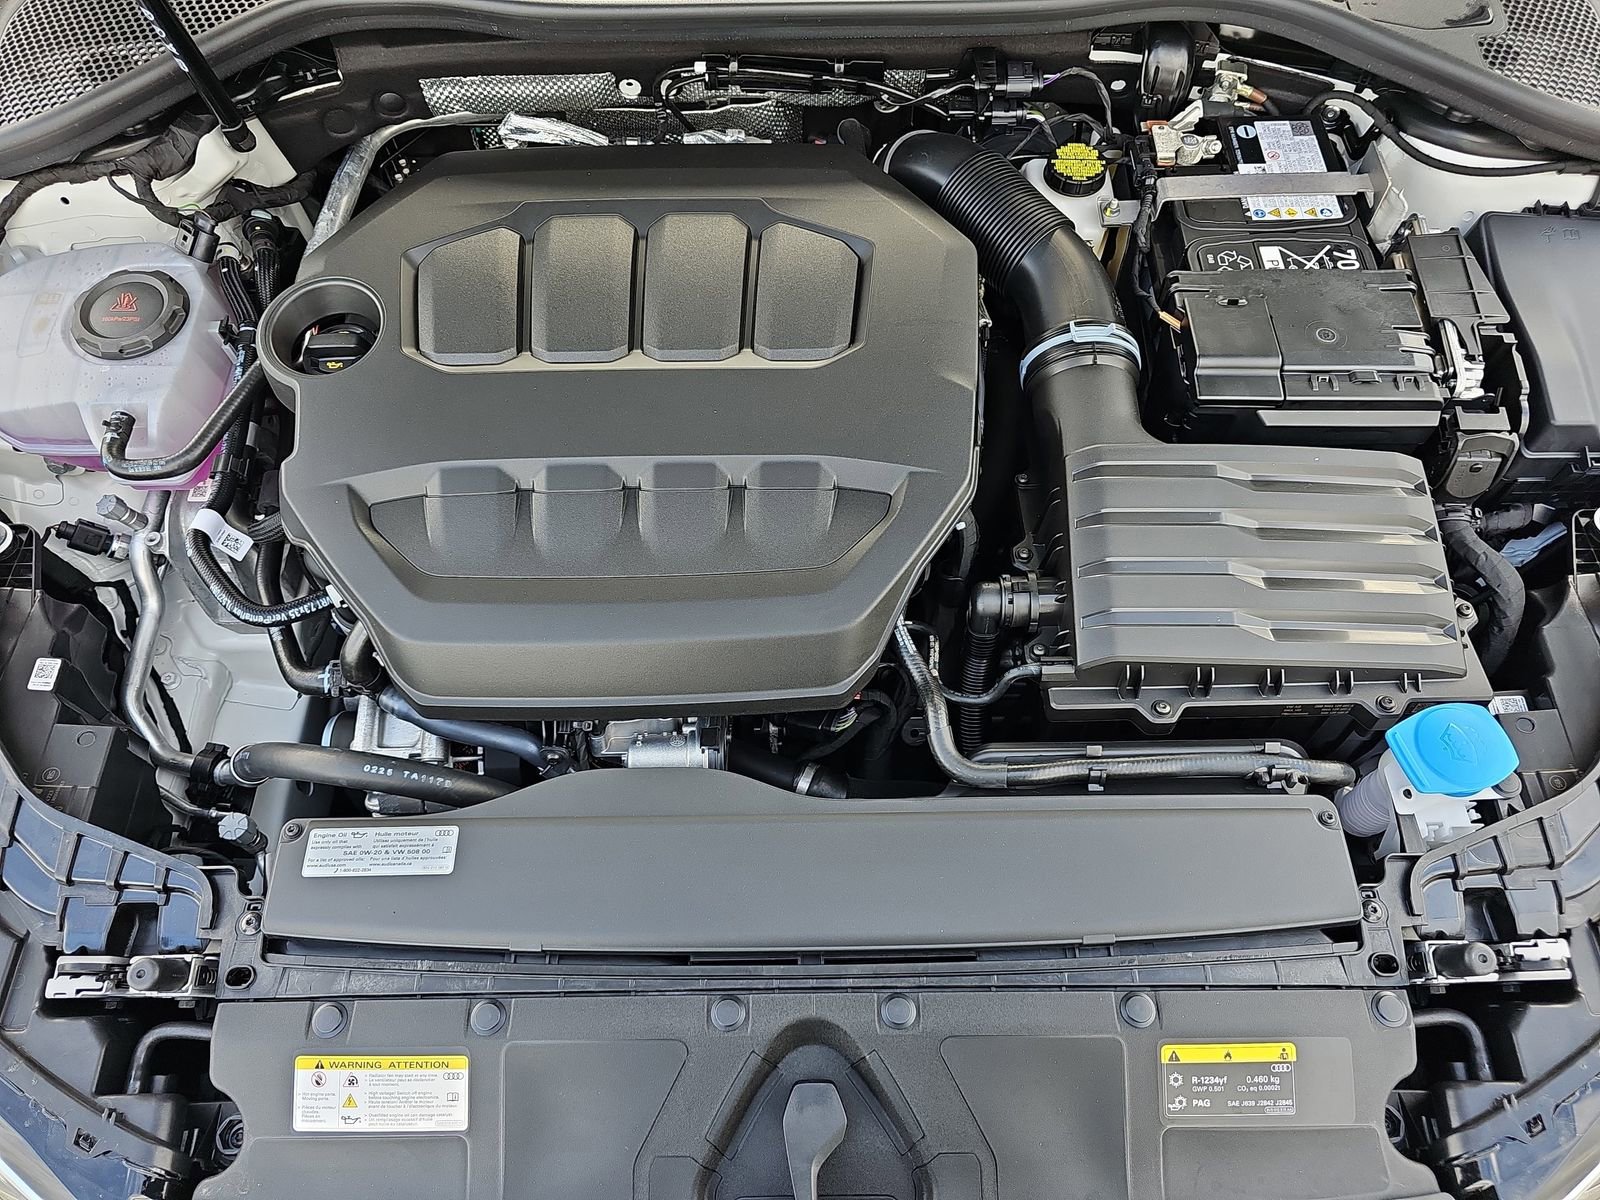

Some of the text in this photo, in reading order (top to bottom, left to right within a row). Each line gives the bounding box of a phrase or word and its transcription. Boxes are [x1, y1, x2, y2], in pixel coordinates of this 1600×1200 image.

[1332, 249, 1360, 270] 70
[1192, 1076, 1227, 1085] R-1234yf
[1270, 1076, 1280, 1084] kg
